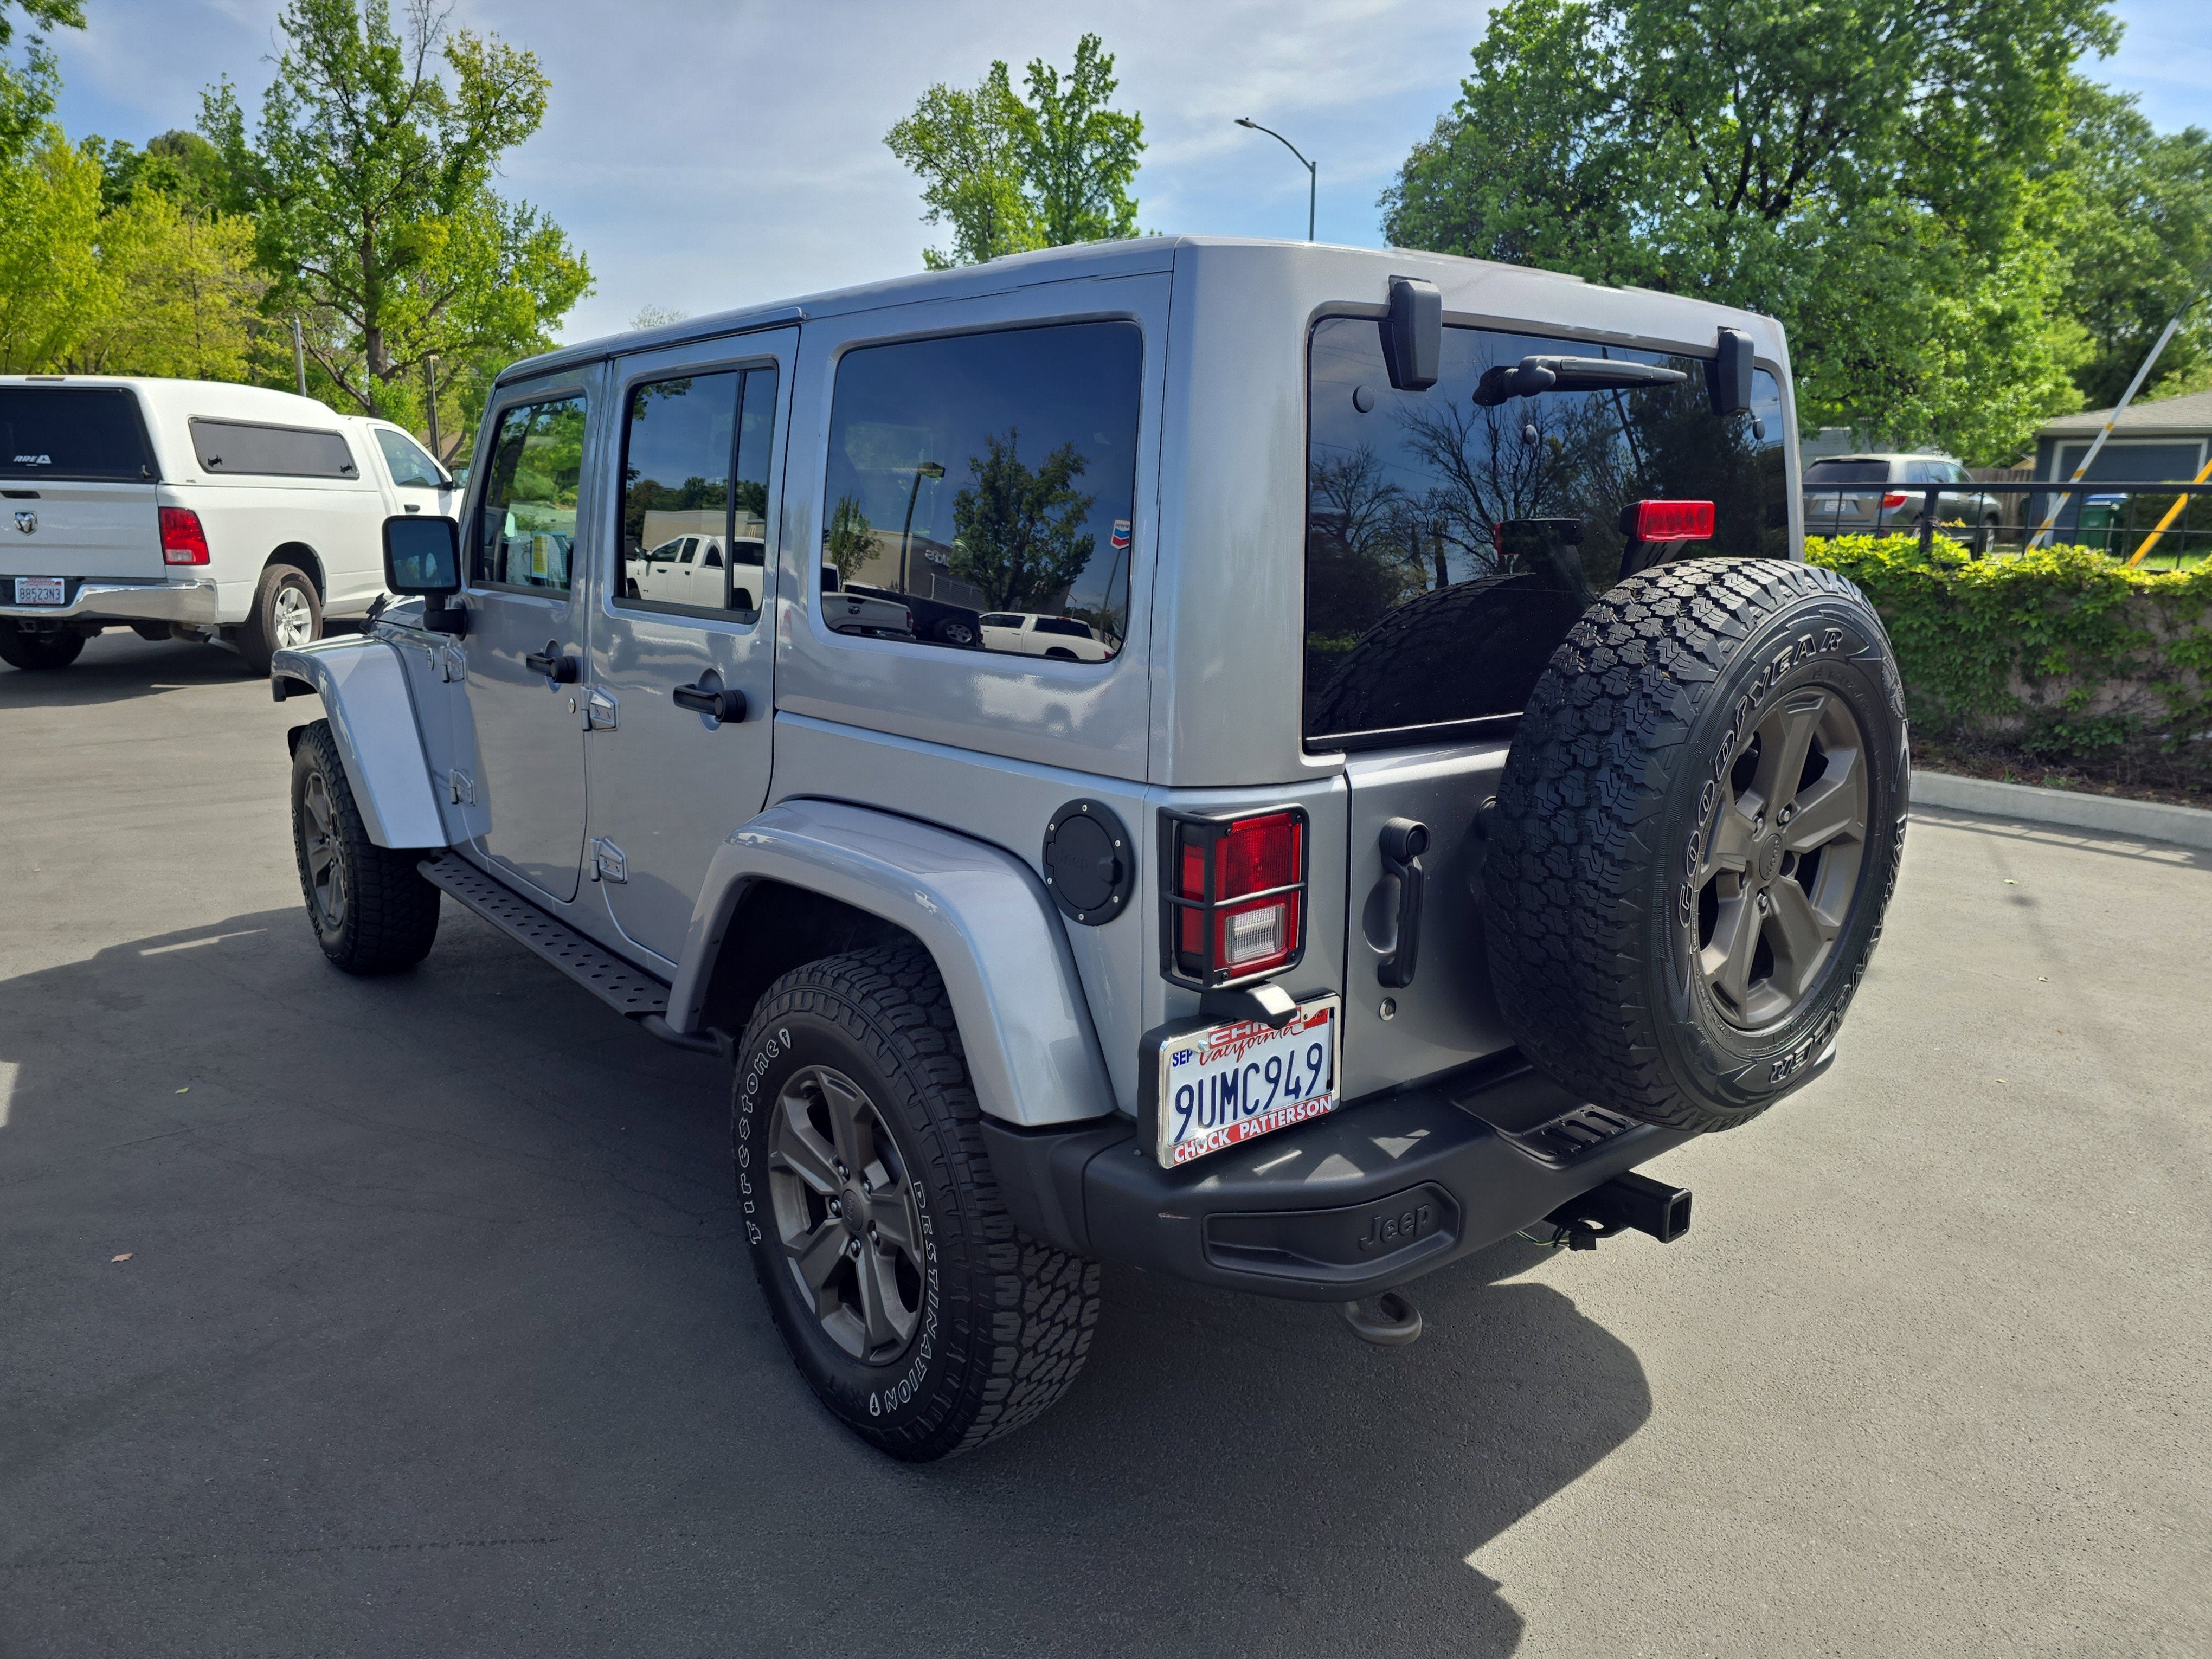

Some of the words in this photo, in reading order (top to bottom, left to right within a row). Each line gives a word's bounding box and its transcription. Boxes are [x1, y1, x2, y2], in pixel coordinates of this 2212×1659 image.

[1679, 628, 1843, 928] GOODYEAR
[1172, 1049, 1193, 1068] SEP
[1174, 1043, 1323, 1142] 9UMC949
[1239, 1095, 1333, 1140] PATTERSON
[1358, 1204, 1433, 1251] Jeep
[884, 1182, 938, 1413] DESTINATION
